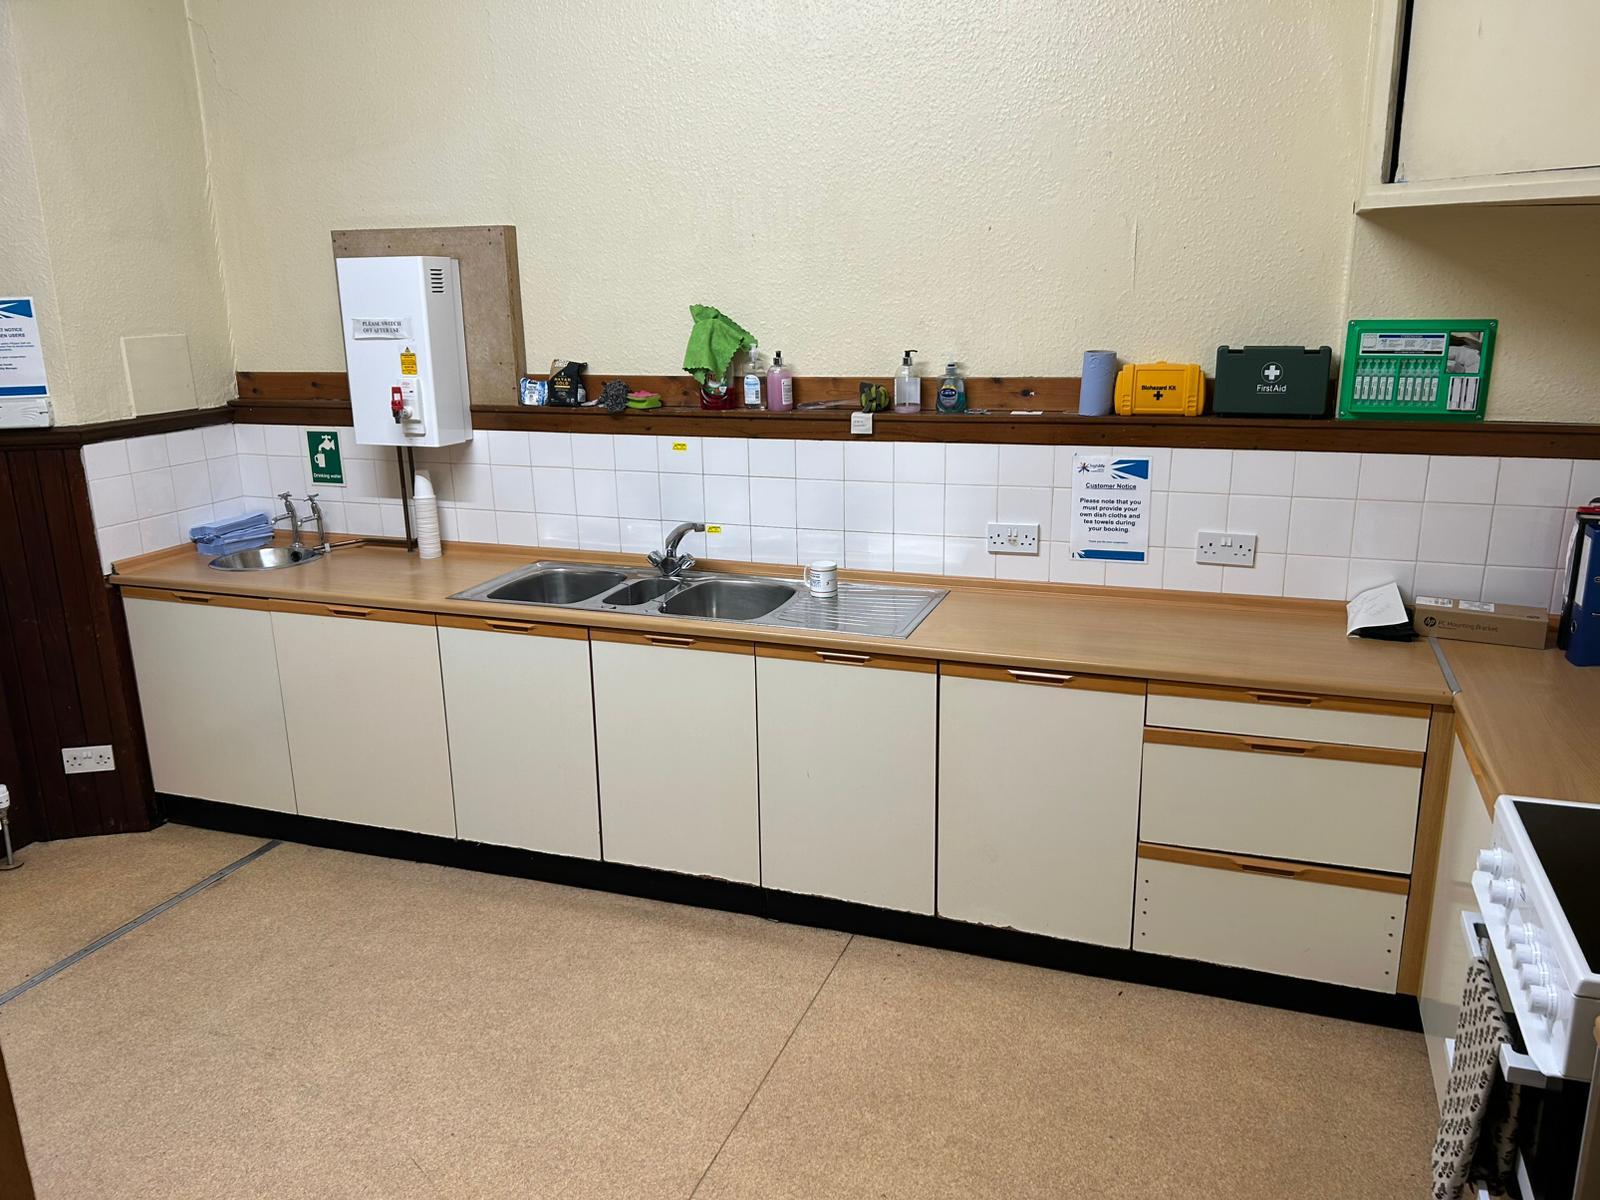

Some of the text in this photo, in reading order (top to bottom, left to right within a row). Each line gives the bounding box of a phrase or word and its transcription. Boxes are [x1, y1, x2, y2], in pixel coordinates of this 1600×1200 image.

[1256, 384, 1287, 392] First Aid
[1085, 482, 1115, 490] Customer
